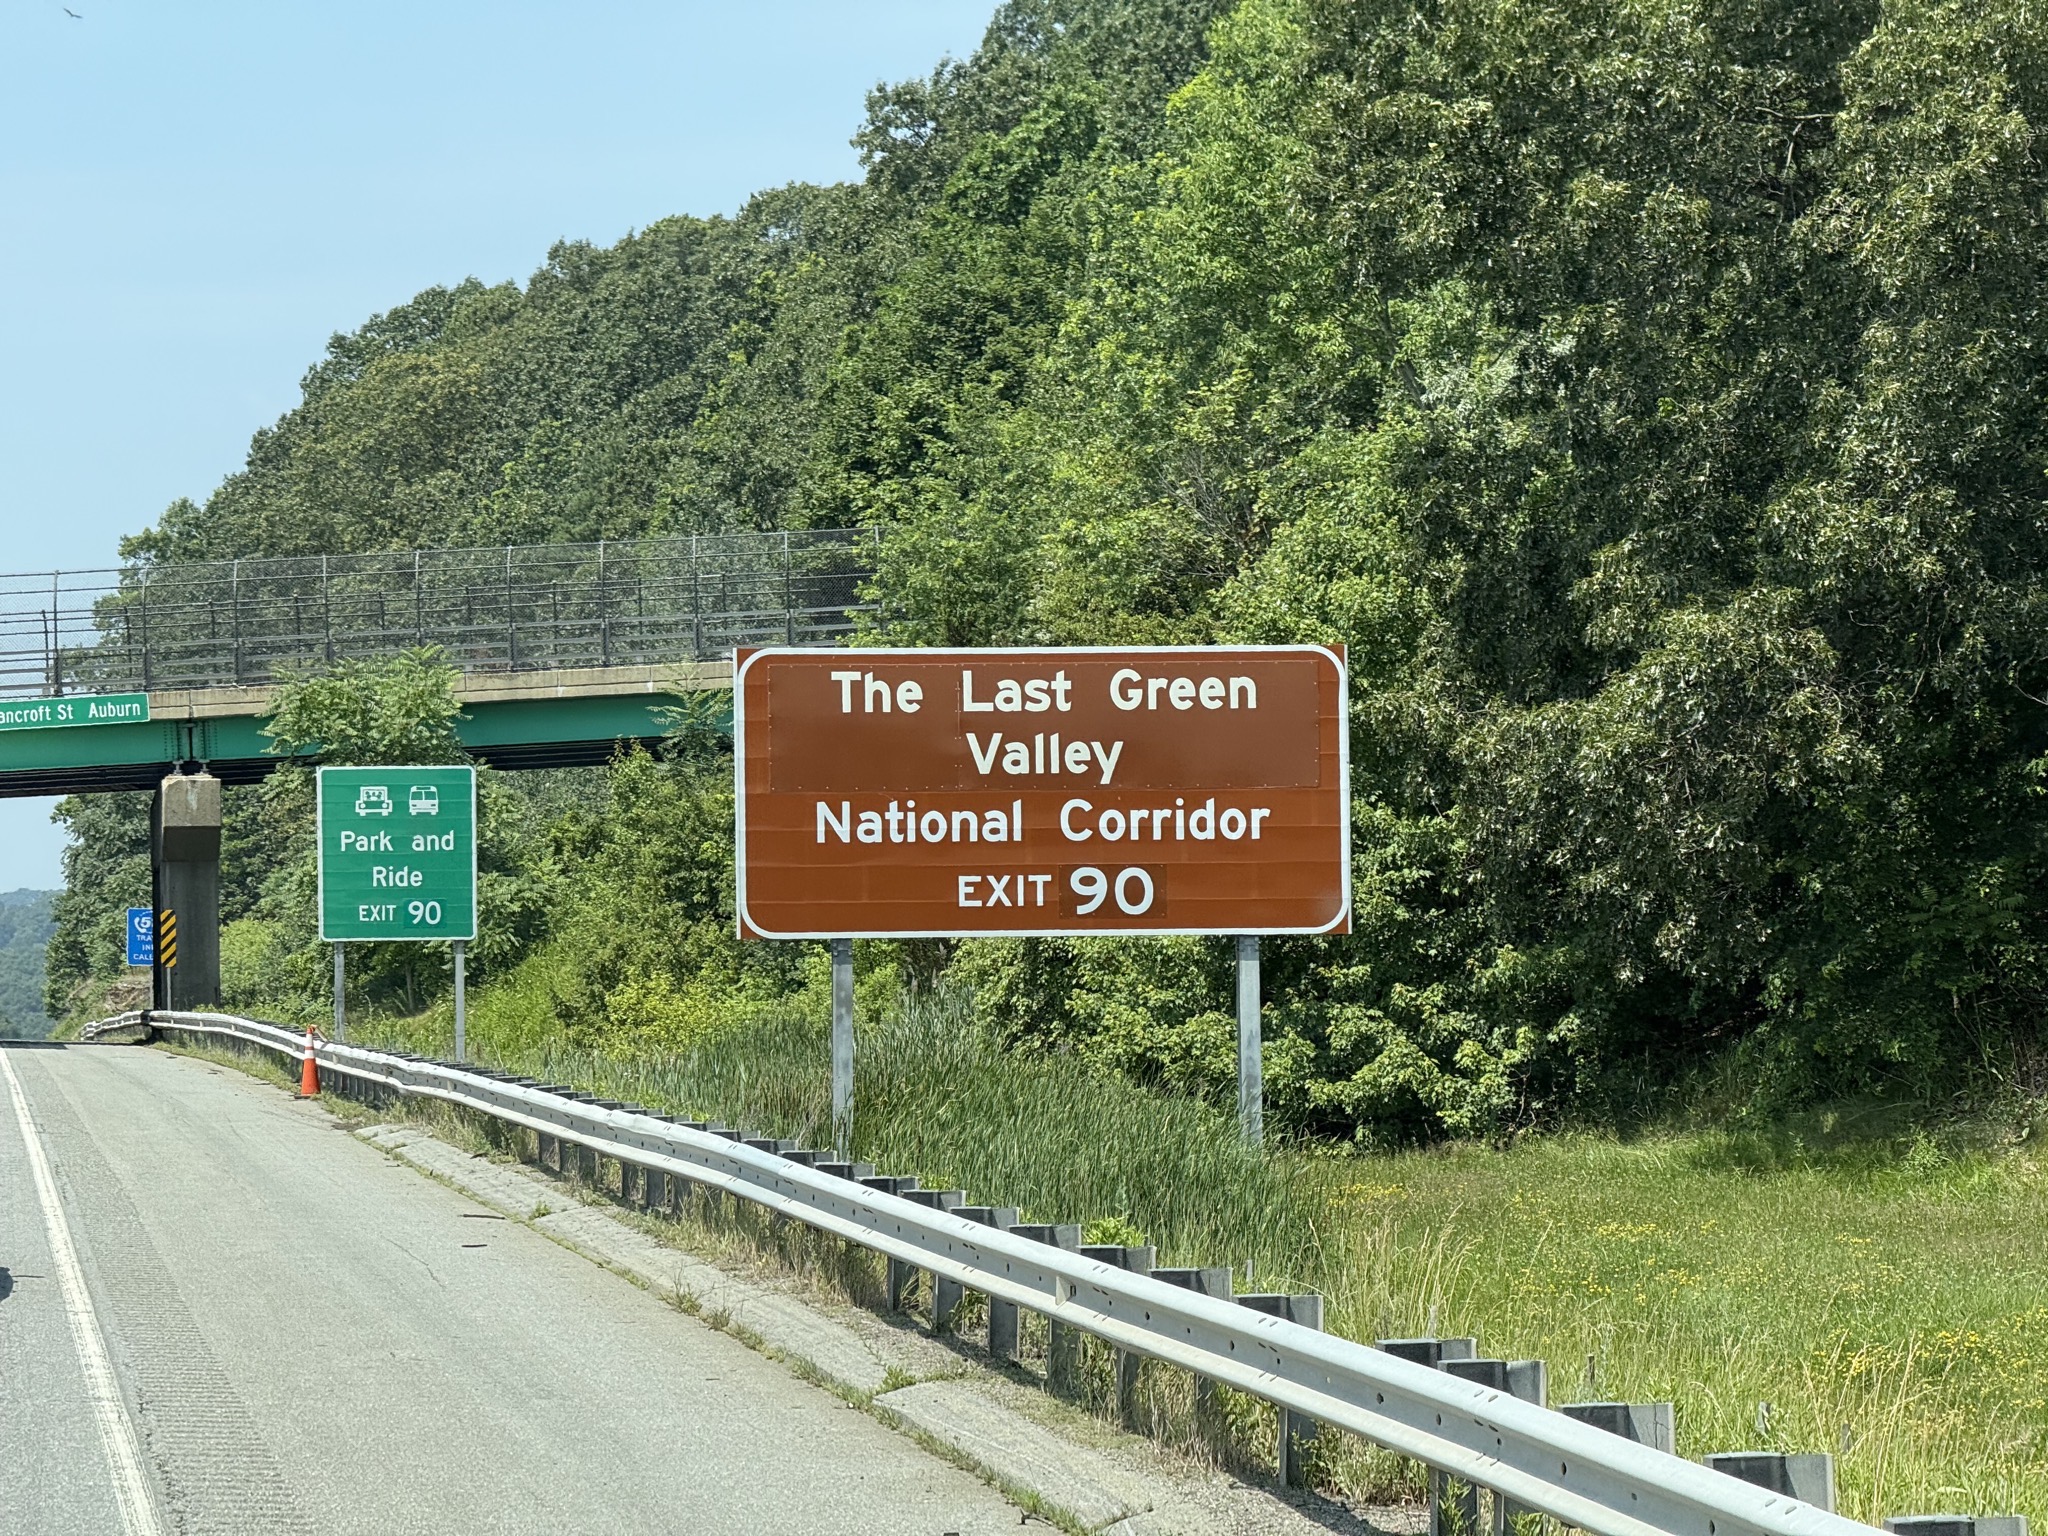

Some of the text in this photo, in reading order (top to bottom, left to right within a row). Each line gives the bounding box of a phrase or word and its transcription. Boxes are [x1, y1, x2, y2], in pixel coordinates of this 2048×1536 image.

[831, 668, 1257, 714] The Last Green
[57, 703, 74, 720] St
[88, 702, 141, 718] Auburn
[966, 732, 1124, 785] Valley
[816, 797, 1271, 844] National Corridor
[340, 829, 454, 852] Park and
[372, 865, 423, 887] Ride
[958, 866, 1154, 915] EXIT 90
[358, 900, 442, 925] EXIT 90
